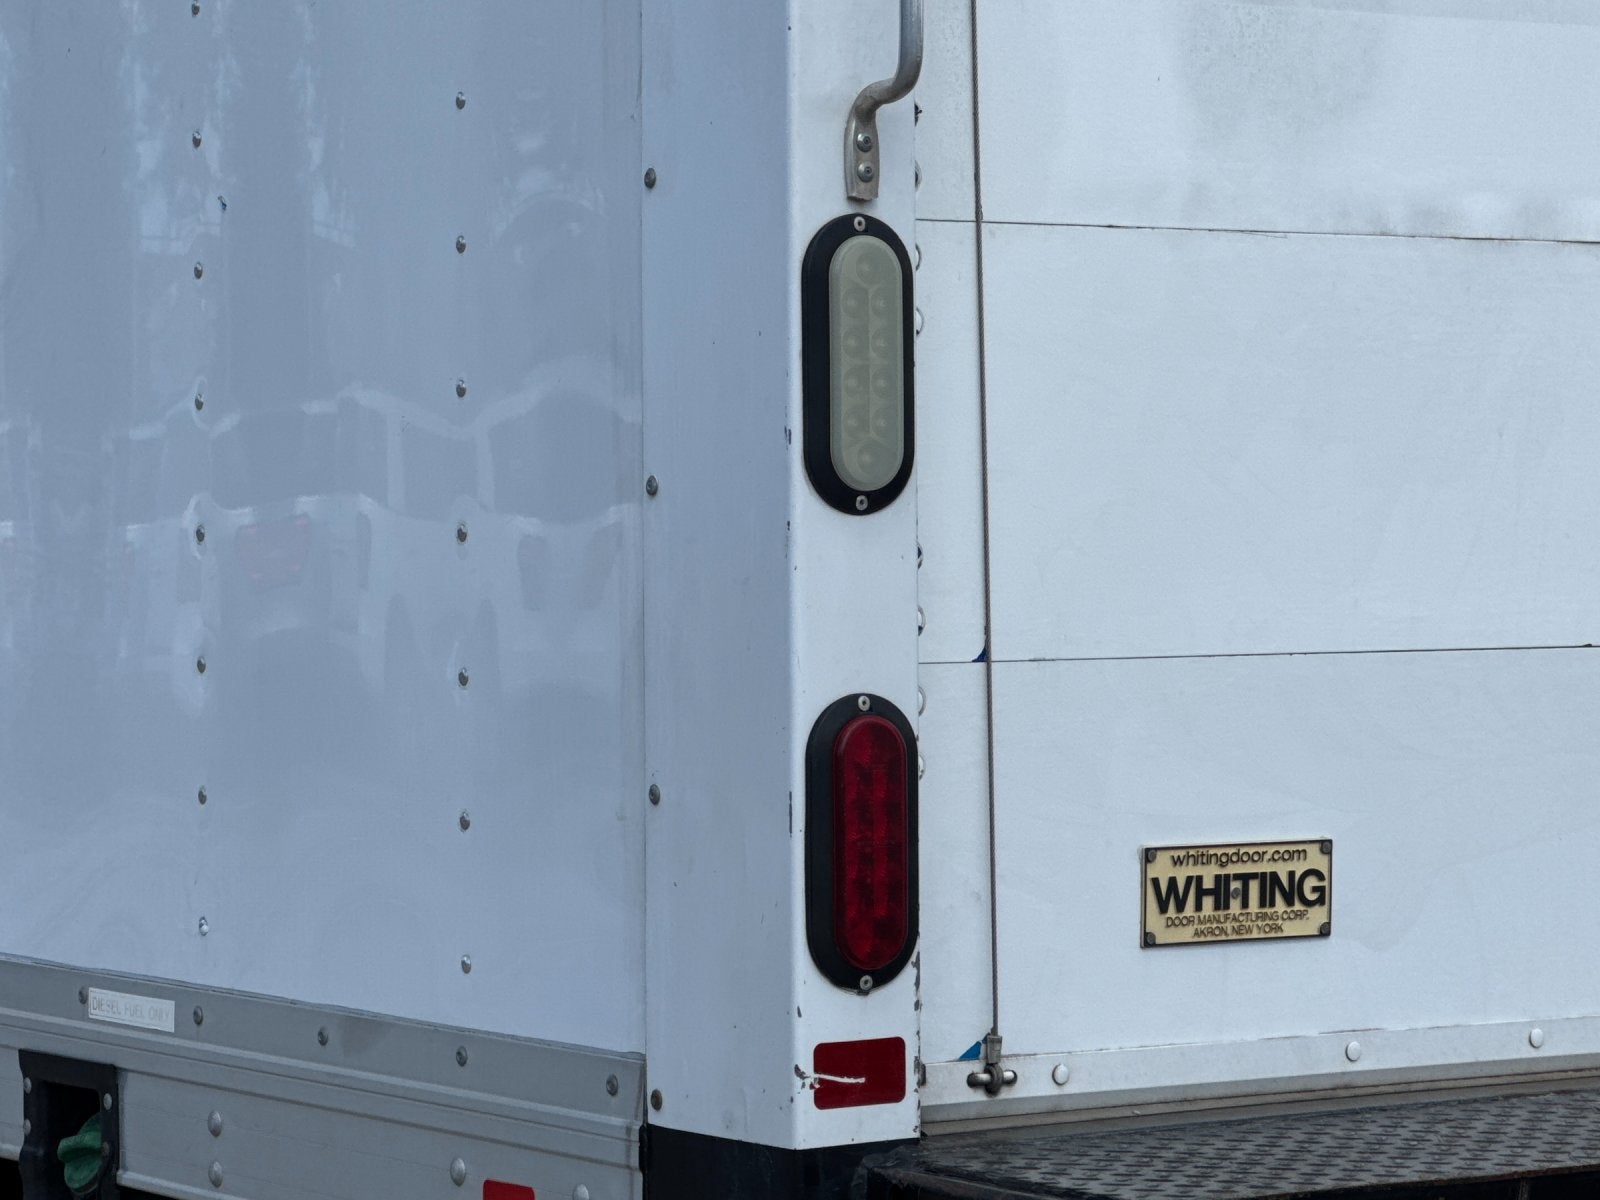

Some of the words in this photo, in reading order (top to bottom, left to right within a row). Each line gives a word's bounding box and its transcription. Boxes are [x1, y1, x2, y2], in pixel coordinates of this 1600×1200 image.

[1171, 848, 1308, 867] whitingdoor.com
[1151, 868, 1327, 914] WHITING
[1166, 916, 1196, 928] DOOR
[1197, 910, 1280, 926] MANUFACTURING
[1281, 909, 1309, 921] CORP.
[1192, 925, 1229, 938] AKRON,
[1231, 924, 1254, 936] NEW
[1255, 923, 1284, 935] YORK
[91, 996, 122, 1015] DIESEL
[124, 1002, 145, 1018] FUEL
[148, 1005, 171, 1020] ONLY
